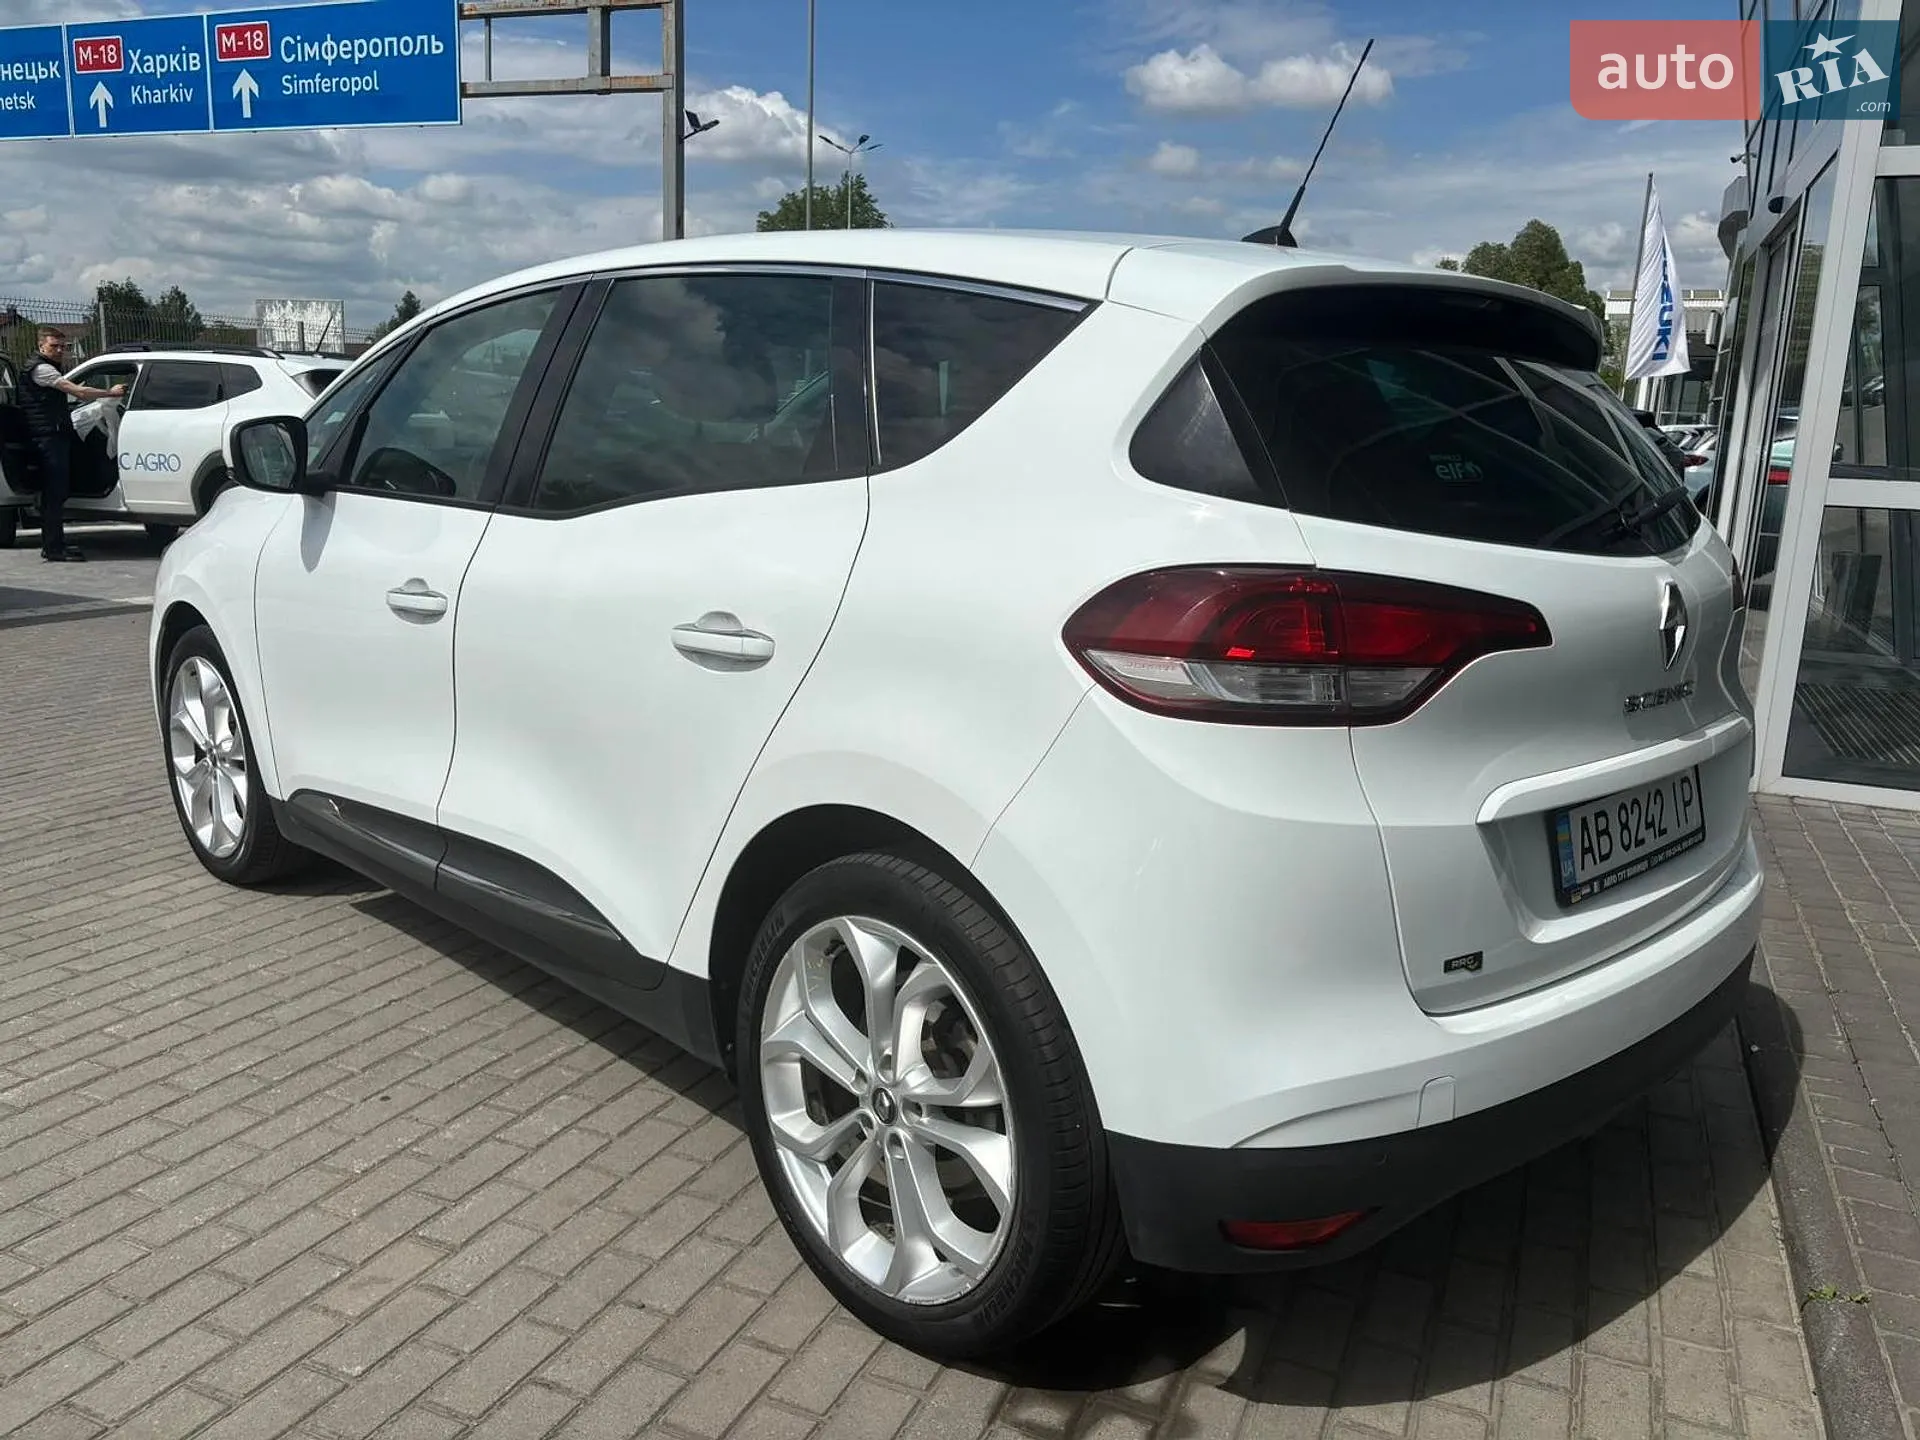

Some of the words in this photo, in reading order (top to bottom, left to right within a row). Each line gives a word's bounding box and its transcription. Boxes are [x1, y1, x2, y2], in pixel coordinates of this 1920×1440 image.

[128, 46, 201, 79] Харків
[280, 33, 444, 66] Сімферополь
[131, 82, 194, 104] Kharkiv
[281, 70, 379, 97] Simferopol
[134, 453, 181, 472] AGRO
[1580, 810, 1613, 871] AB
[1617, 787, 1668, 852] 8242
[1672, 775, 1693, 829] IP
